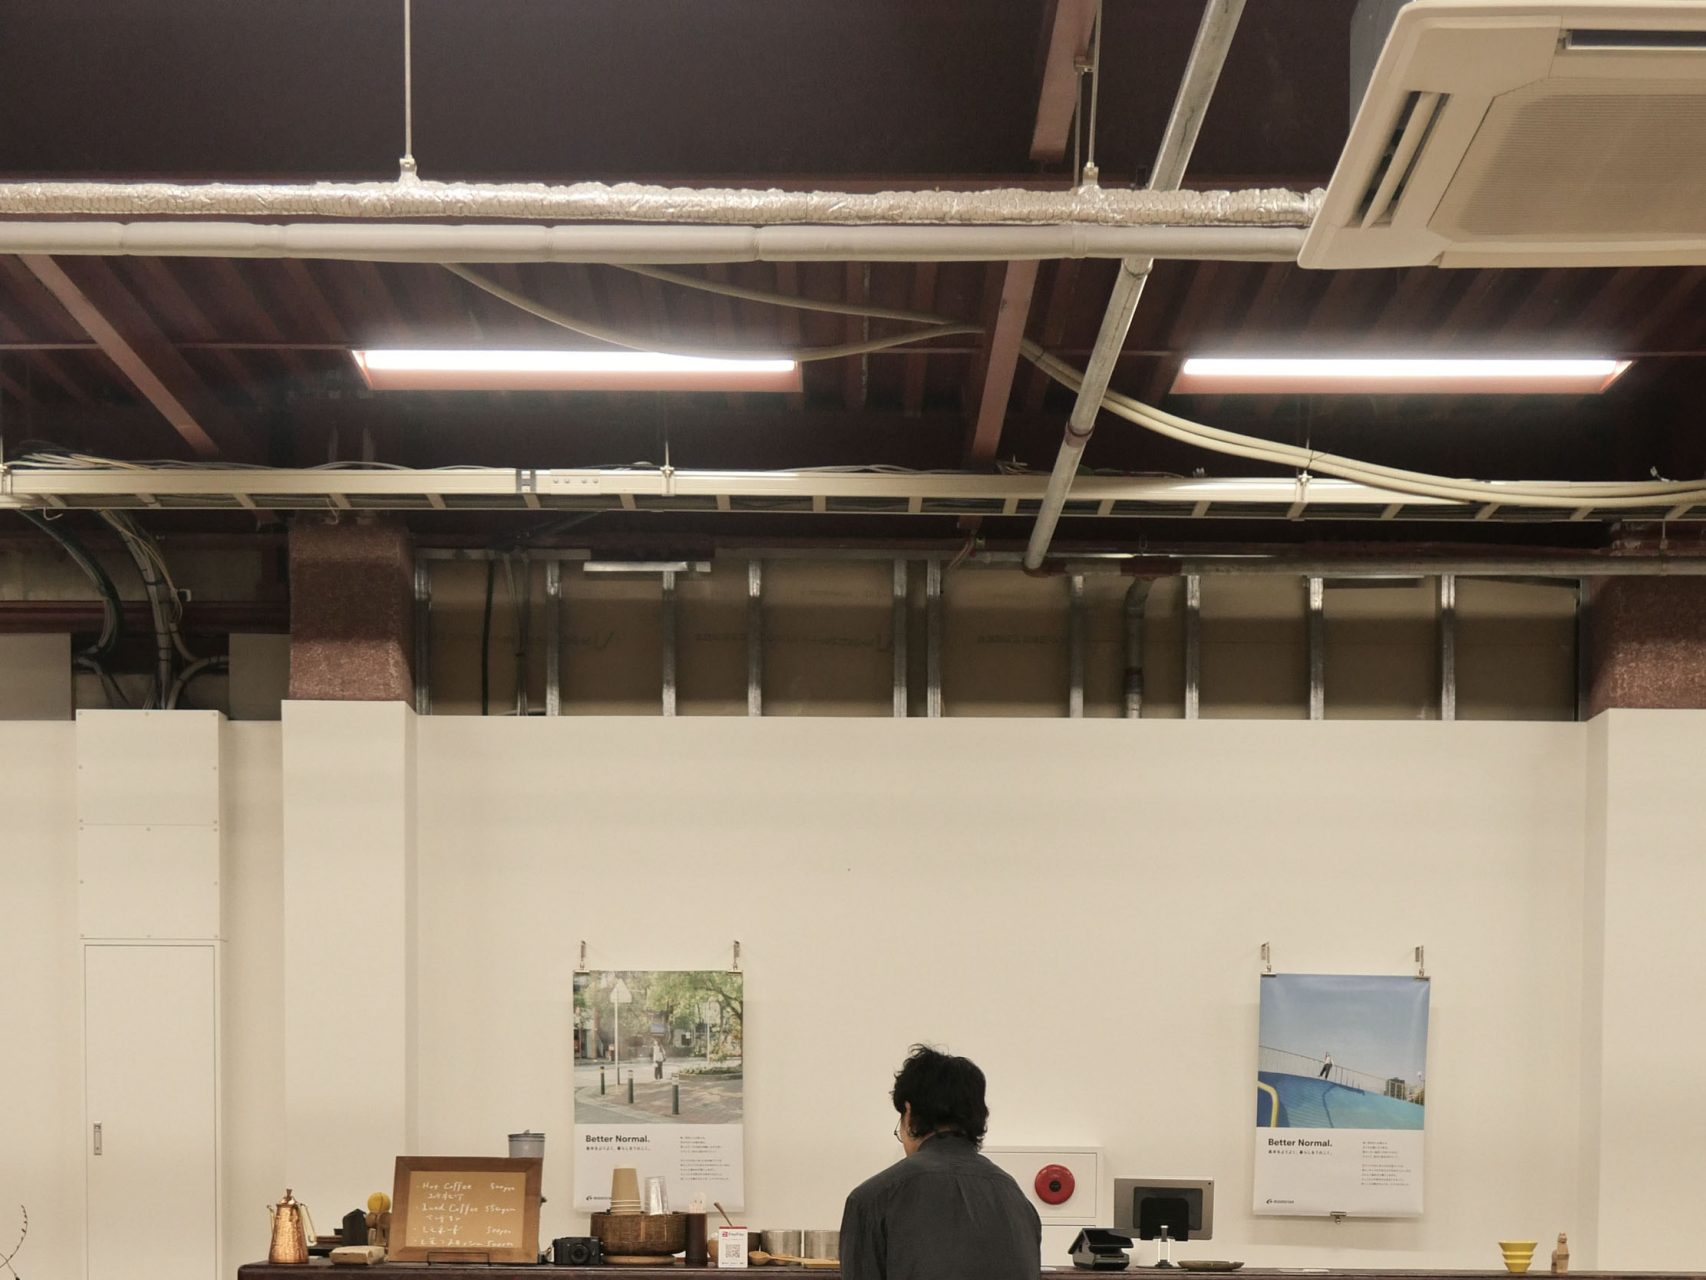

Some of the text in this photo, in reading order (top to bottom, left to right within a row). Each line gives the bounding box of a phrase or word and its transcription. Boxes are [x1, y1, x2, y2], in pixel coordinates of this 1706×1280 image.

[585, 1134, 651, 1143] Better Normal.
[1268, 1138, 1333, 1147] Better Normal.
[443, 1181, 472, 1191] Coffee
[448, 1203, 478, 1215] Coffee
